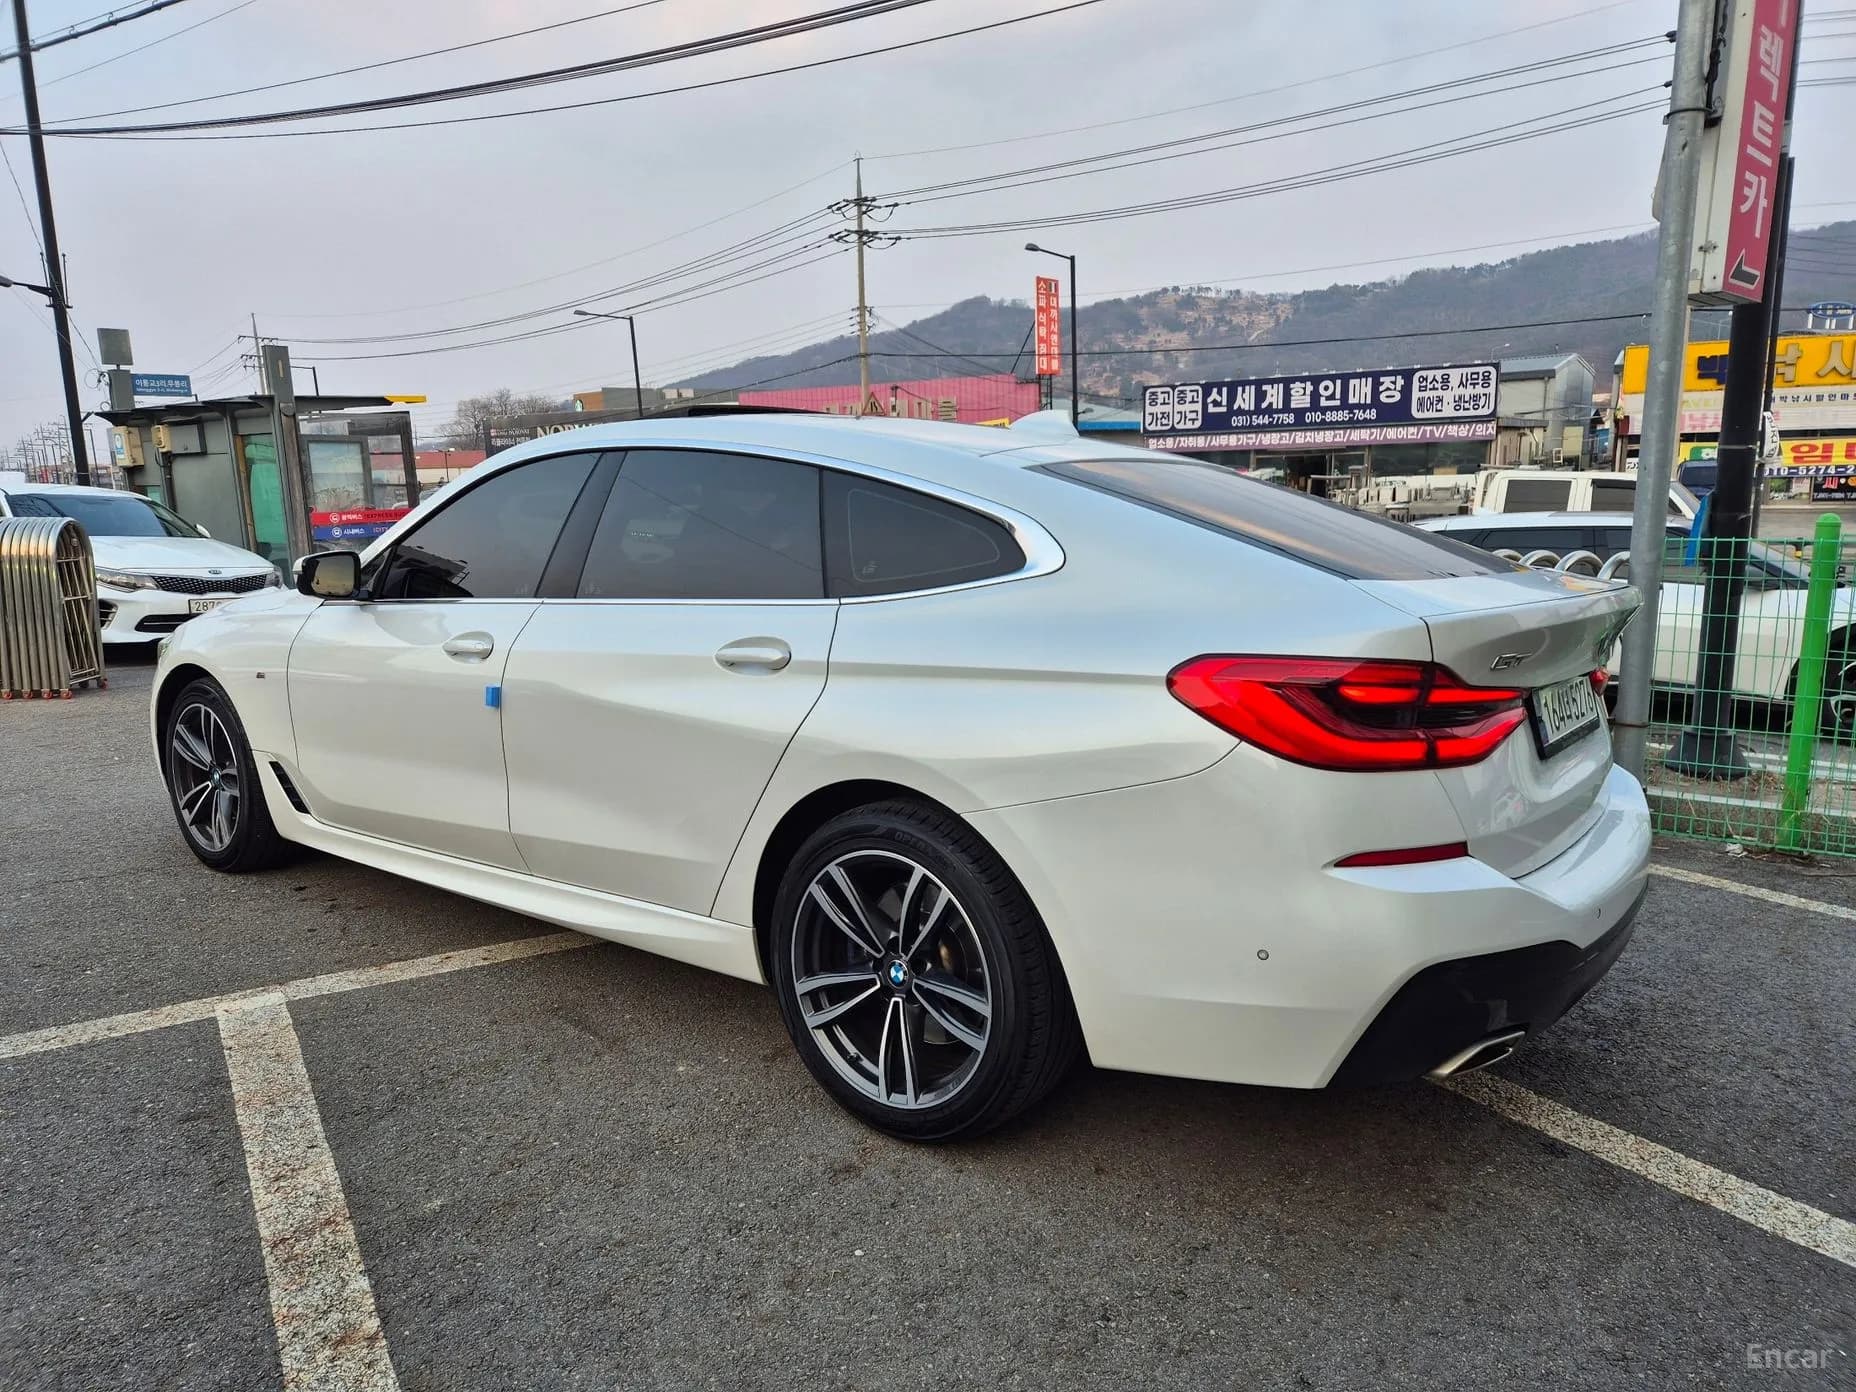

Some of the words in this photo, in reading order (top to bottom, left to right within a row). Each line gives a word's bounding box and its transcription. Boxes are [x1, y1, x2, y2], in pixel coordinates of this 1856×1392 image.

[1740, 0, 1788, 239] 렉트카
[1417, 373, 1454, 393] 업소용,
[1458, 370, 1492, 389] 사무용
[1149, 391, 1171, 407] 중고
[1176, 388, 1199, 405] 중고
[1207, 375, 1404, 413] 신세계할인매장
[1416, 395, 1443, 413] 에어컨
[1453, 393, 1491, 411] 냉난방기
[1148, 411, 1170, 427] 가전
[1176, 409, 1199, 426] 가구
[1252, 413, 1294, 426] 544-7758
[1305, 409, 1376, 423] 010-8885-7648
[1790, 441, 1856, 465] 임
[1490, 653, 1533, 671] GT
